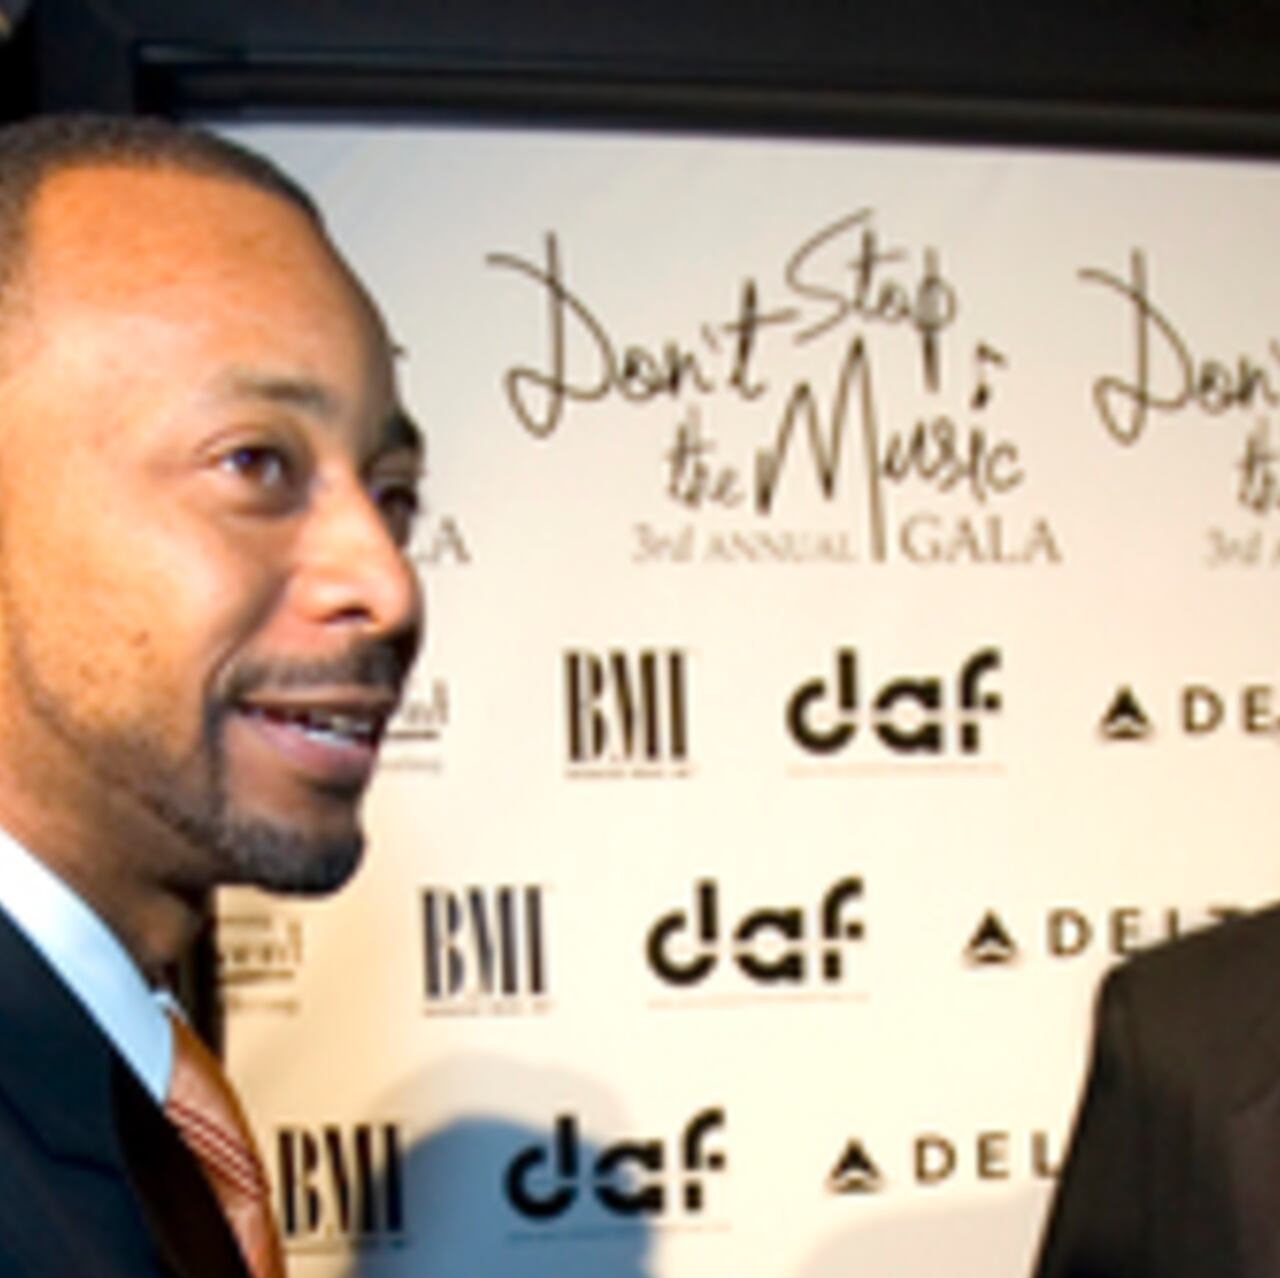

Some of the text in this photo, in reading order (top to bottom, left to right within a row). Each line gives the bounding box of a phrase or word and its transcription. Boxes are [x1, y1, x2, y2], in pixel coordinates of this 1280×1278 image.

[483, 207, 959, 440] Don't Stop
[662, 335, 1026, 562] the Music
[701, 528, 857, 563] ANNUAL
[898, 514, 1064, 564] GALA
[563, 650, 688, 763] BMI
[785, 647, 1004, 756] daf
[421, 885, 546, 997] BMI
[645, 876, 865, 987] daf
[277, 1123, 404, 1238] BMI
[504, 1107, 727, 1224] daf
[912, 1129, 1064, 1184] DEL
